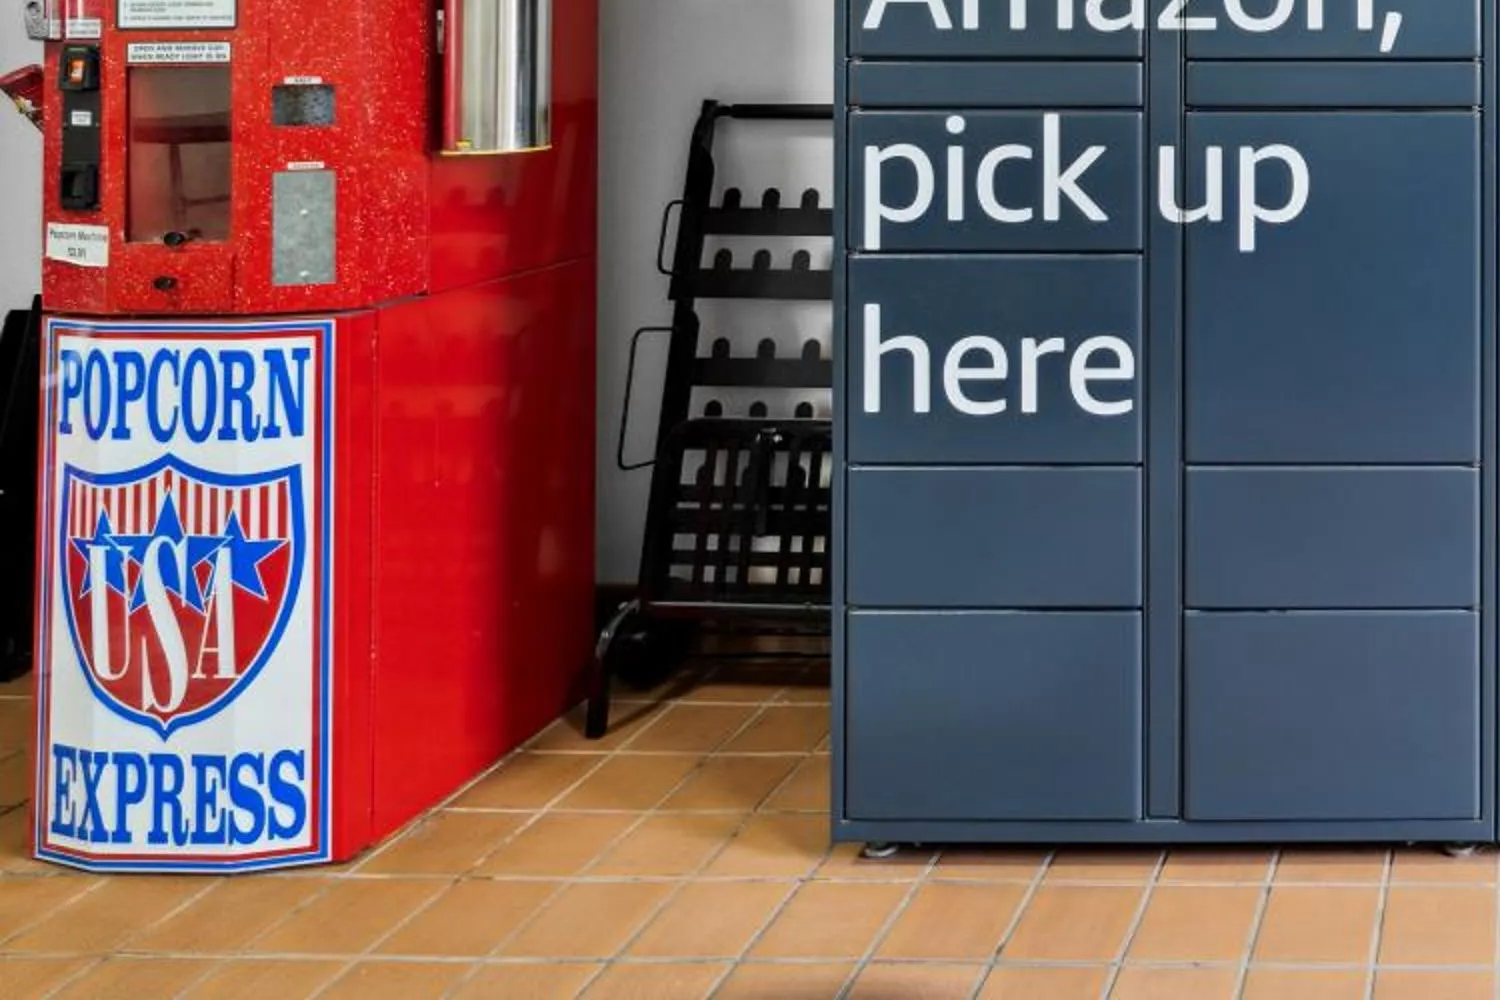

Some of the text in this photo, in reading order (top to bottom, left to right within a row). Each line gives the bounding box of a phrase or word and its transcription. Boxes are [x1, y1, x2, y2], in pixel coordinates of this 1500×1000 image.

[863, 113, 1310, 252] pick up
[59, 347, 311, 443] POPCORN
[863, 304, 1135, 415] here
[89, 535, 243, 714] USA
[51, 744, 307, 846] EXPRESS
